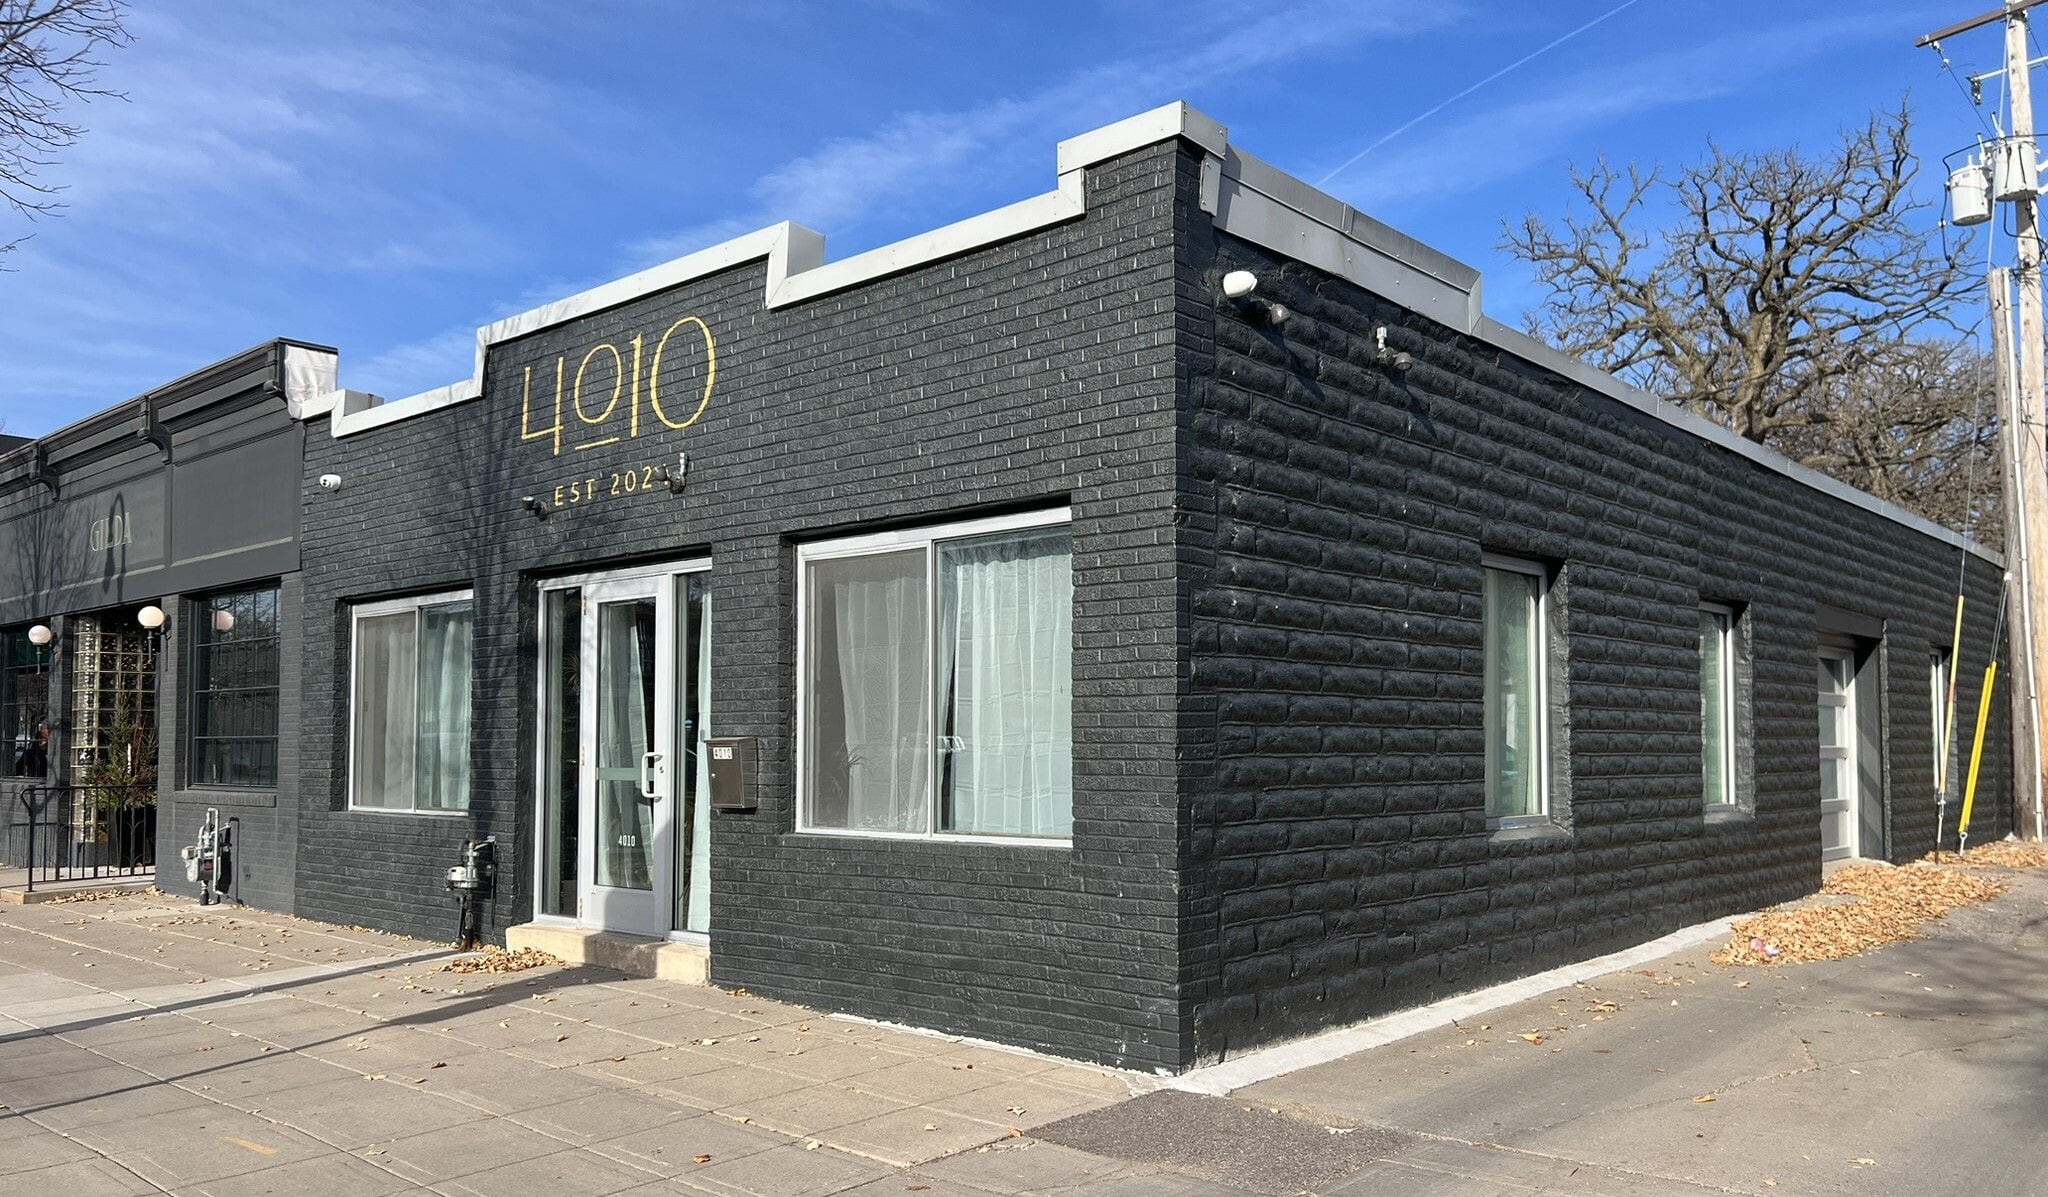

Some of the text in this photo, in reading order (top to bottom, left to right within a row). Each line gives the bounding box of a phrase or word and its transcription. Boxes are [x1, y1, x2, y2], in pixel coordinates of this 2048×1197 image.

[521, 316, 716, 455] 4010
[554, 465, 669, 506] EST 202
[89, 511, 133, 552] GILDA
[618, 834, 636, 847] 4010
